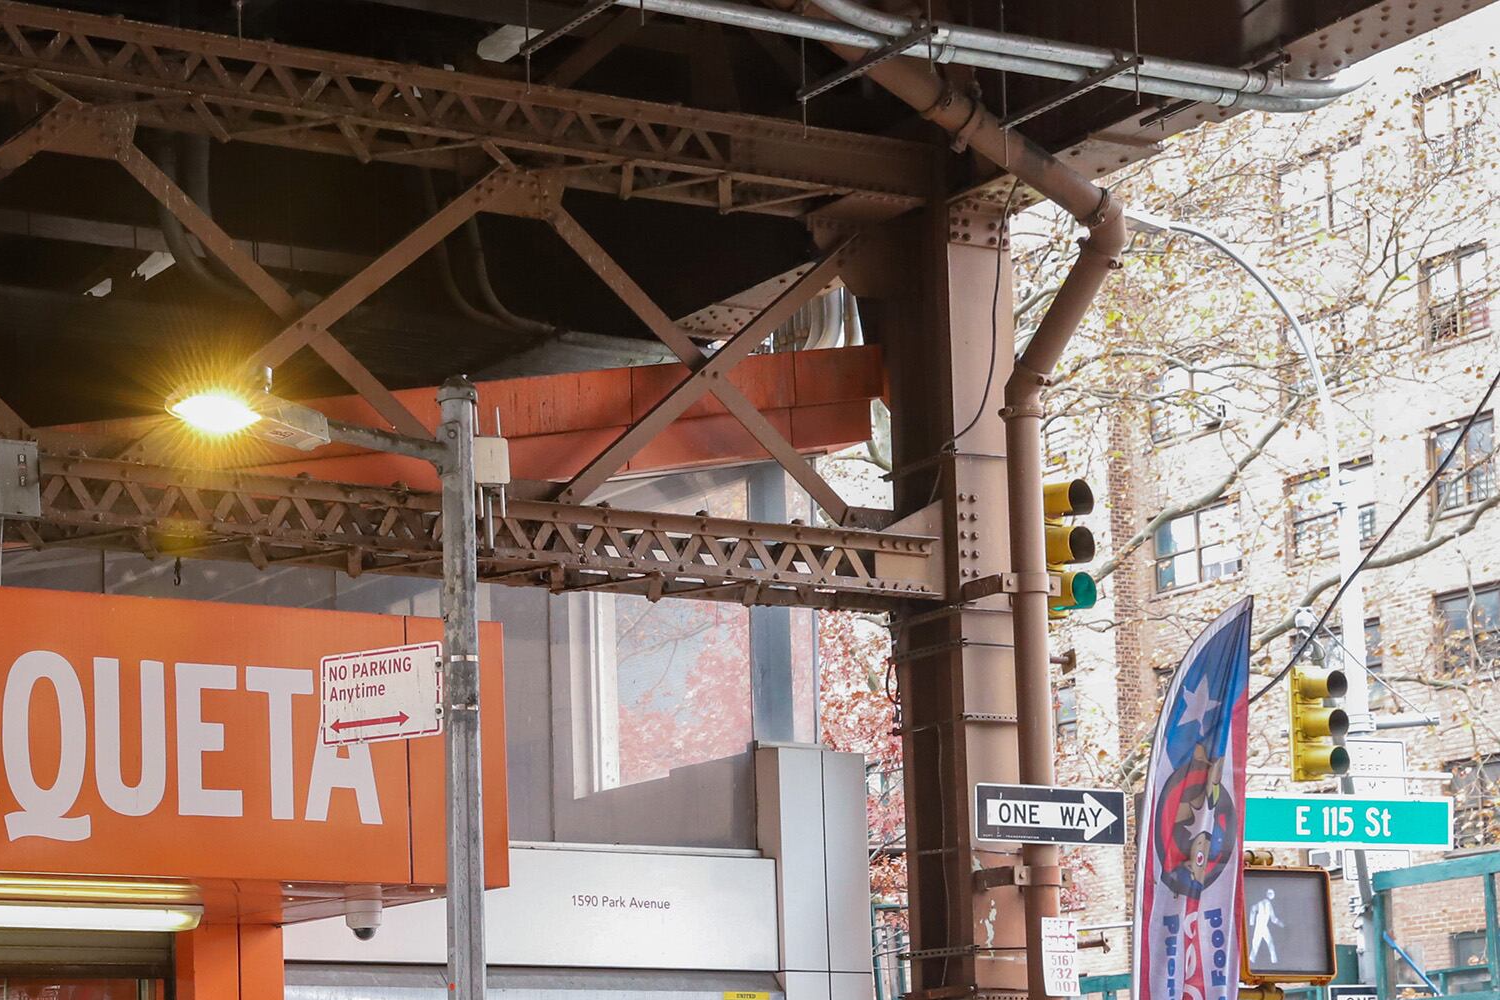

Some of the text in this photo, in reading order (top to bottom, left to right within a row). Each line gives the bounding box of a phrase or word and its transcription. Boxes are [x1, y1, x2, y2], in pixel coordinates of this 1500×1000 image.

[329, 656, 412, 682] NO PARKING
[330, 683, 386, 703] Anytime
[998, 802, 1103, 827] ONE WAY
[1295, 805, 1392, 838] E 115 St
[572, 894, 671, 910] 1590 Park Avenue
[1203, 907, 1228, 987] Food
